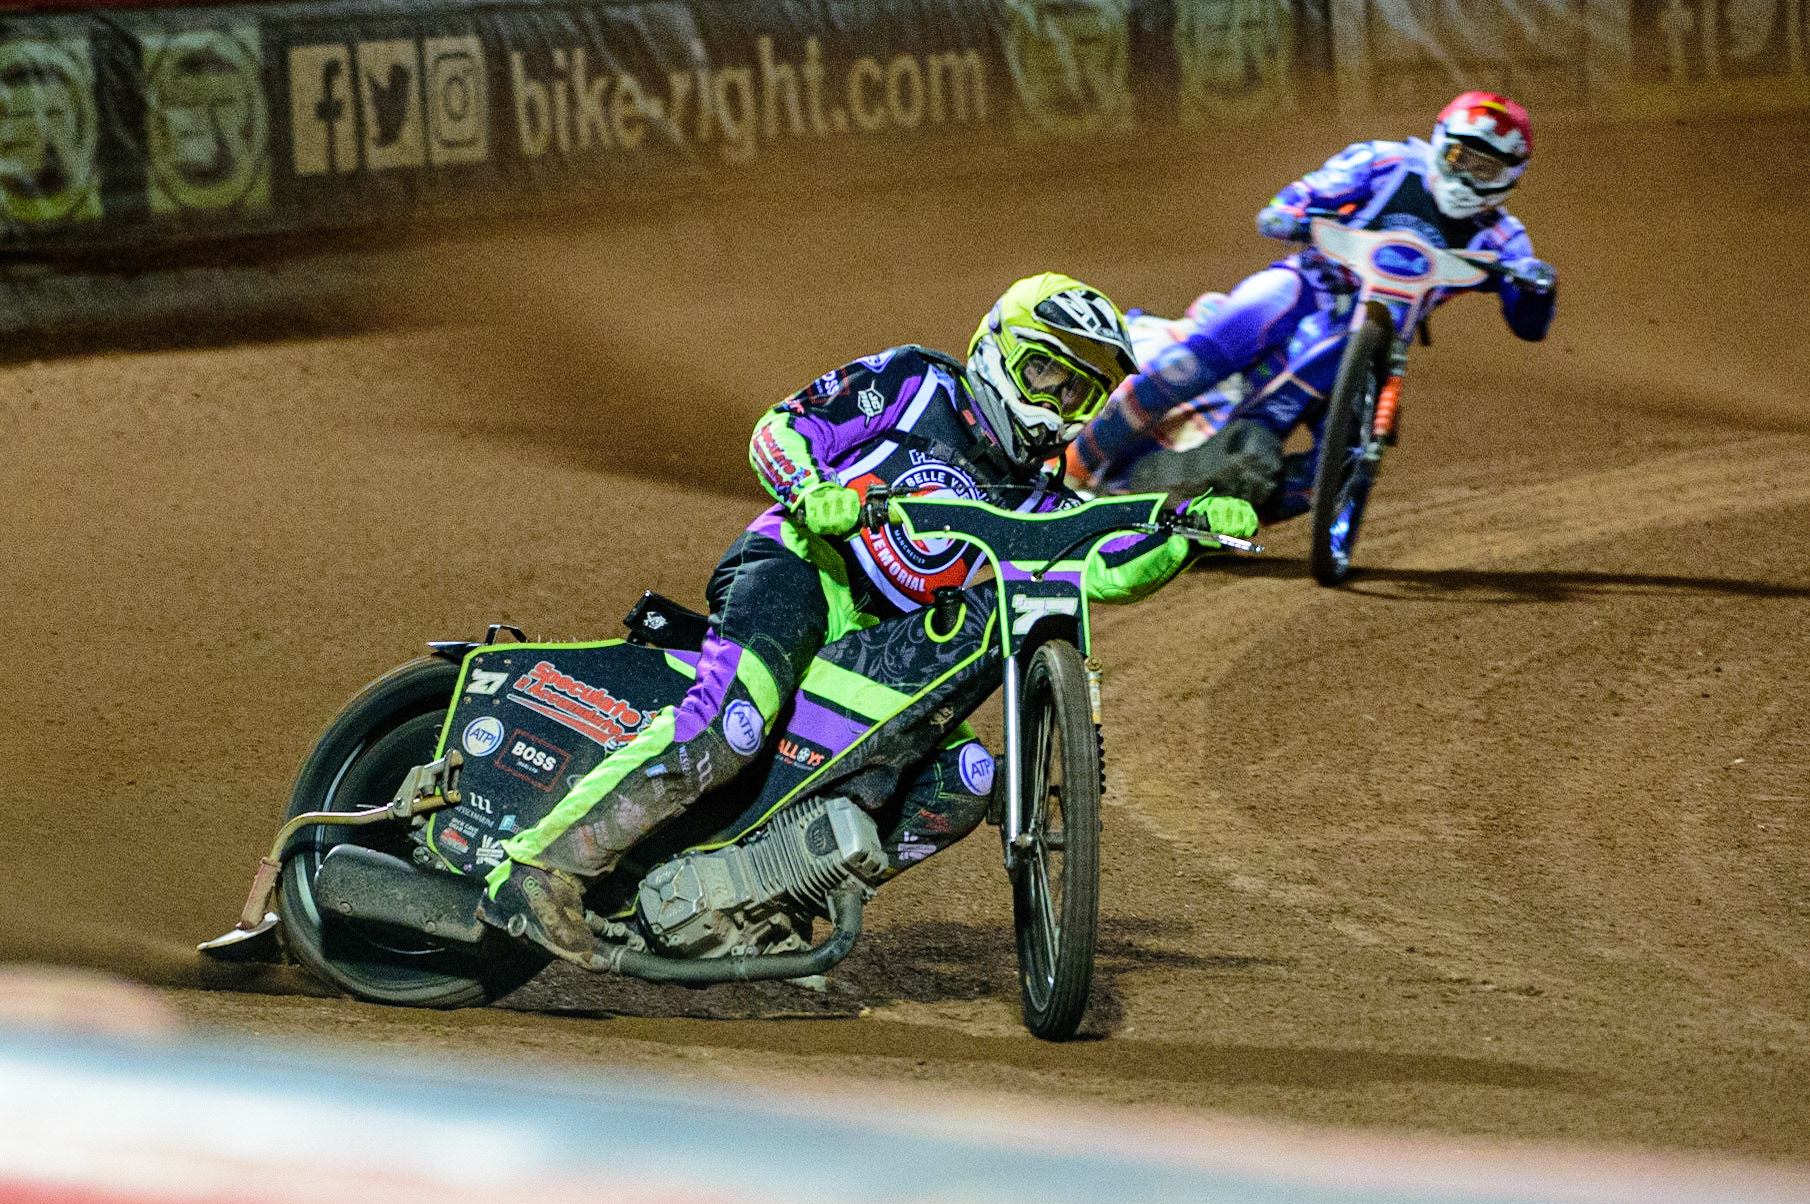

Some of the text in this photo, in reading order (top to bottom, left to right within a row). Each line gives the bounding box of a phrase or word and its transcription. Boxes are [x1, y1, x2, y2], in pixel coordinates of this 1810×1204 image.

[905, 470, 946, 488] BELLE
[469, 727, 497, 747] ATPI
[734, 711, 755, 747] ATPI
[511, 741, 557, 771] BOSS
[970, 759, 991, 779] ATP
